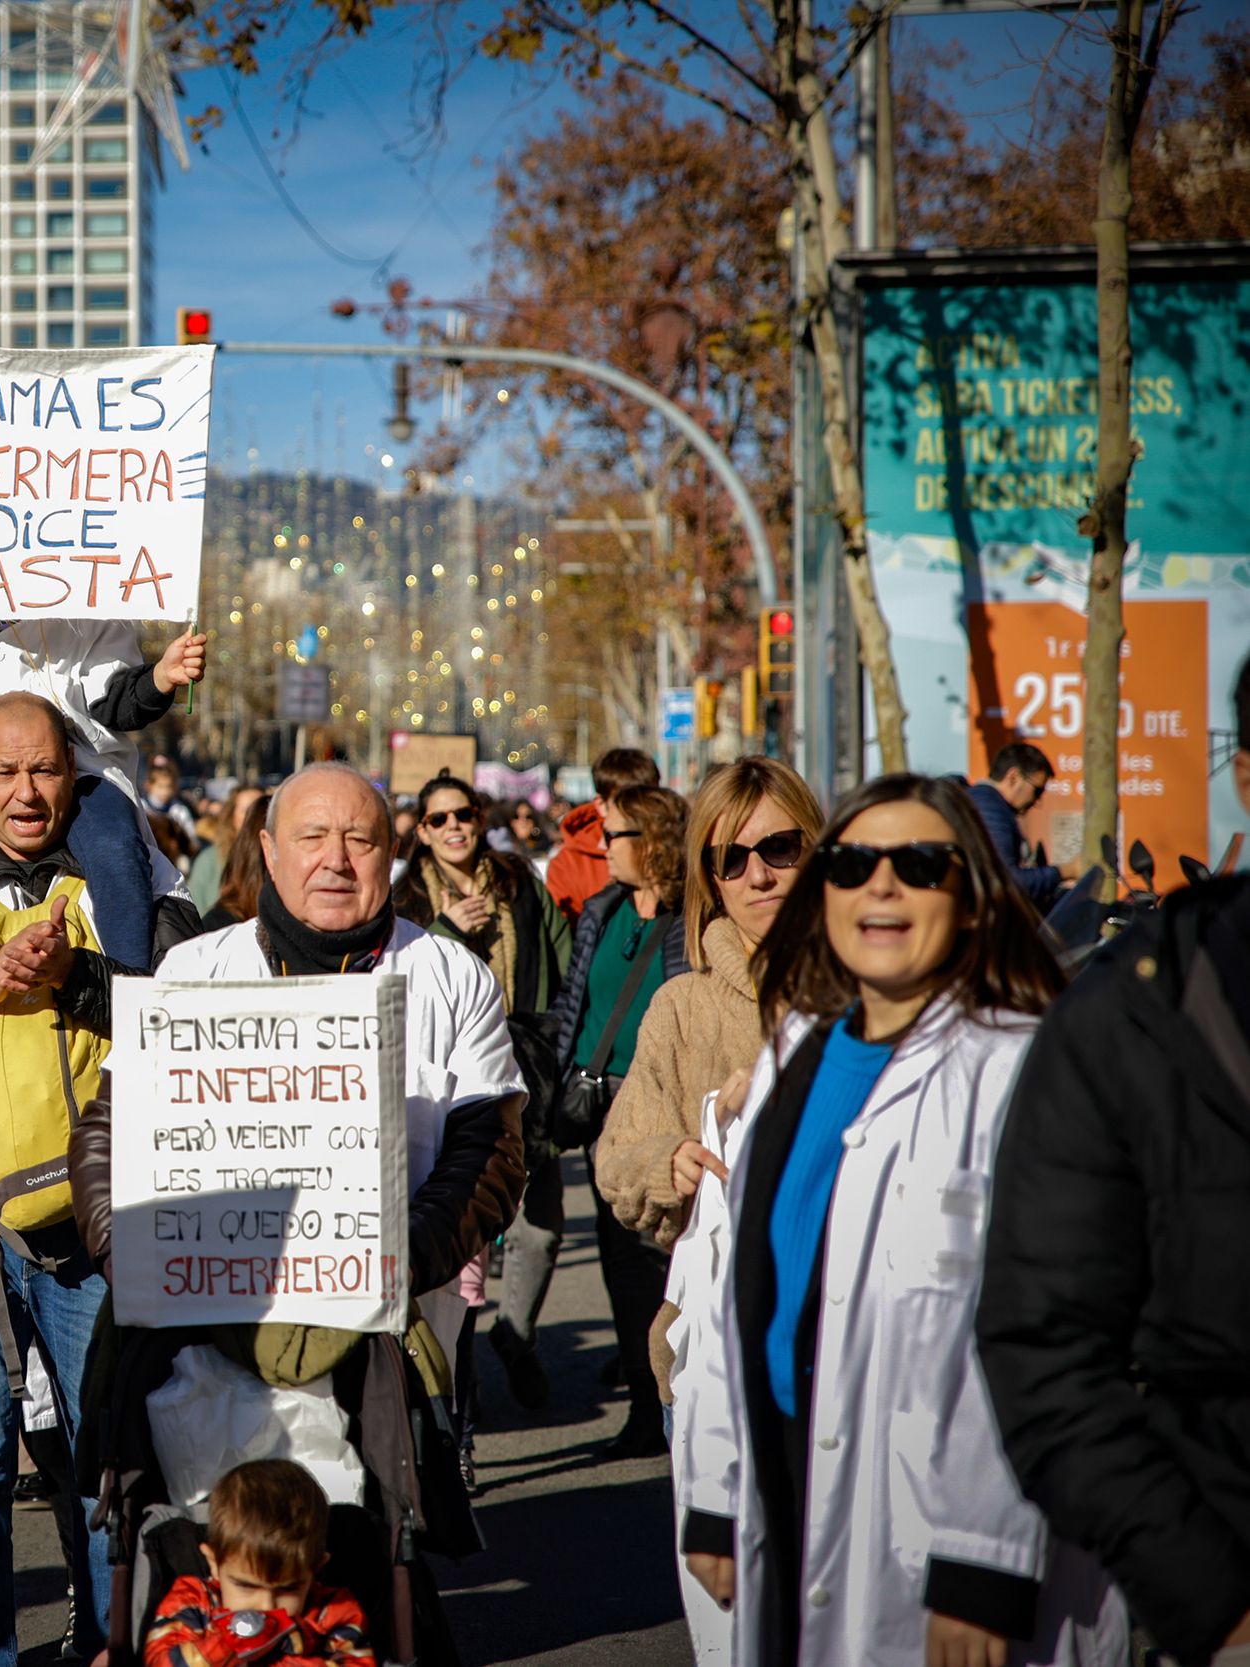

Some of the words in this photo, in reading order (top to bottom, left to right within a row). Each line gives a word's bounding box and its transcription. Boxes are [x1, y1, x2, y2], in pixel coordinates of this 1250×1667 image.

[97, 376, 166, 431] ES
[1026, 425, 1068, 464] UN
[139, 1006, 298, 1052] PENSAVA
[316, 1016, 384, 1051] SER
[168, 1064, 368, 1104] INFERMER
[154, 1119, 217, 1151] PERÒ
[328, 1125, 380, 1150] COM
[25, 1167, 68, 1187] Quechua
[153, 1168, 201, 1192] LES
[216, 1166, 333, 1192] TRACTEU
[154, 1210, 202, 1242] EM
[218, 1209, 321, 1245] QUEDO
[333, 1211, 380, 1240] DE
